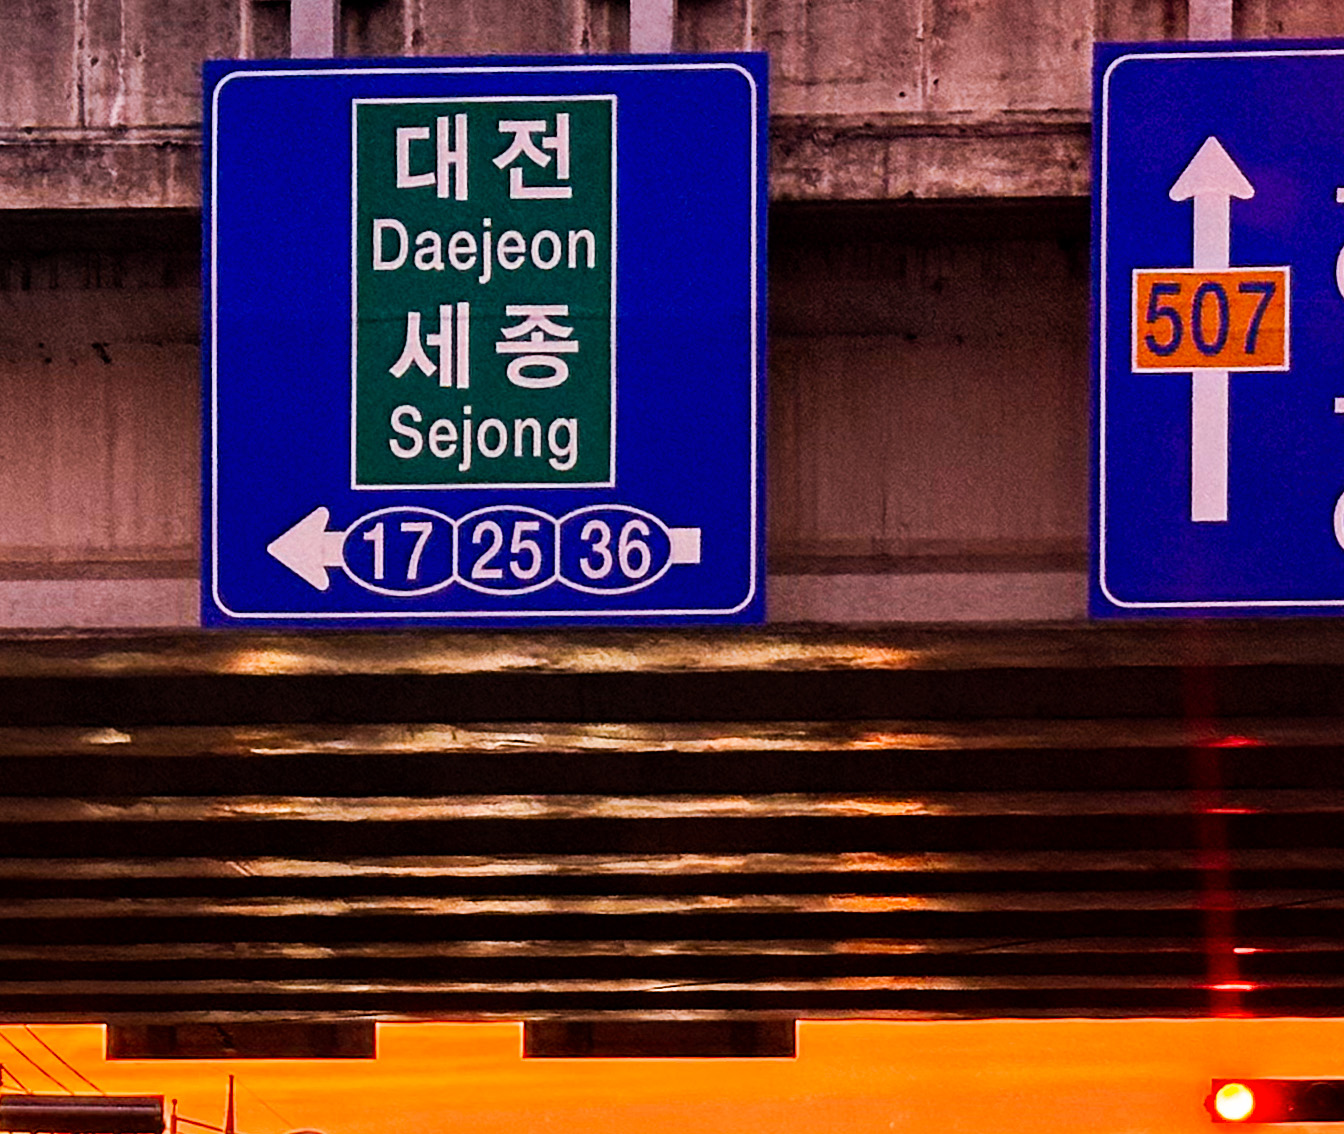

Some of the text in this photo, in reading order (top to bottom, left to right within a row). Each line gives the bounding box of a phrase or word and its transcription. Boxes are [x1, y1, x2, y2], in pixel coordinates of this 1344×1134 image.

[395, 112, 574, 201] 대전
[371, 217, 597, 284] Daejeon
[388, 300, 580, 390] 세종
[1143, 280, 1278, 357] 507
[388, 404, 580, 472] Sejong
[362, 519, 653, 580] 17 25 36
